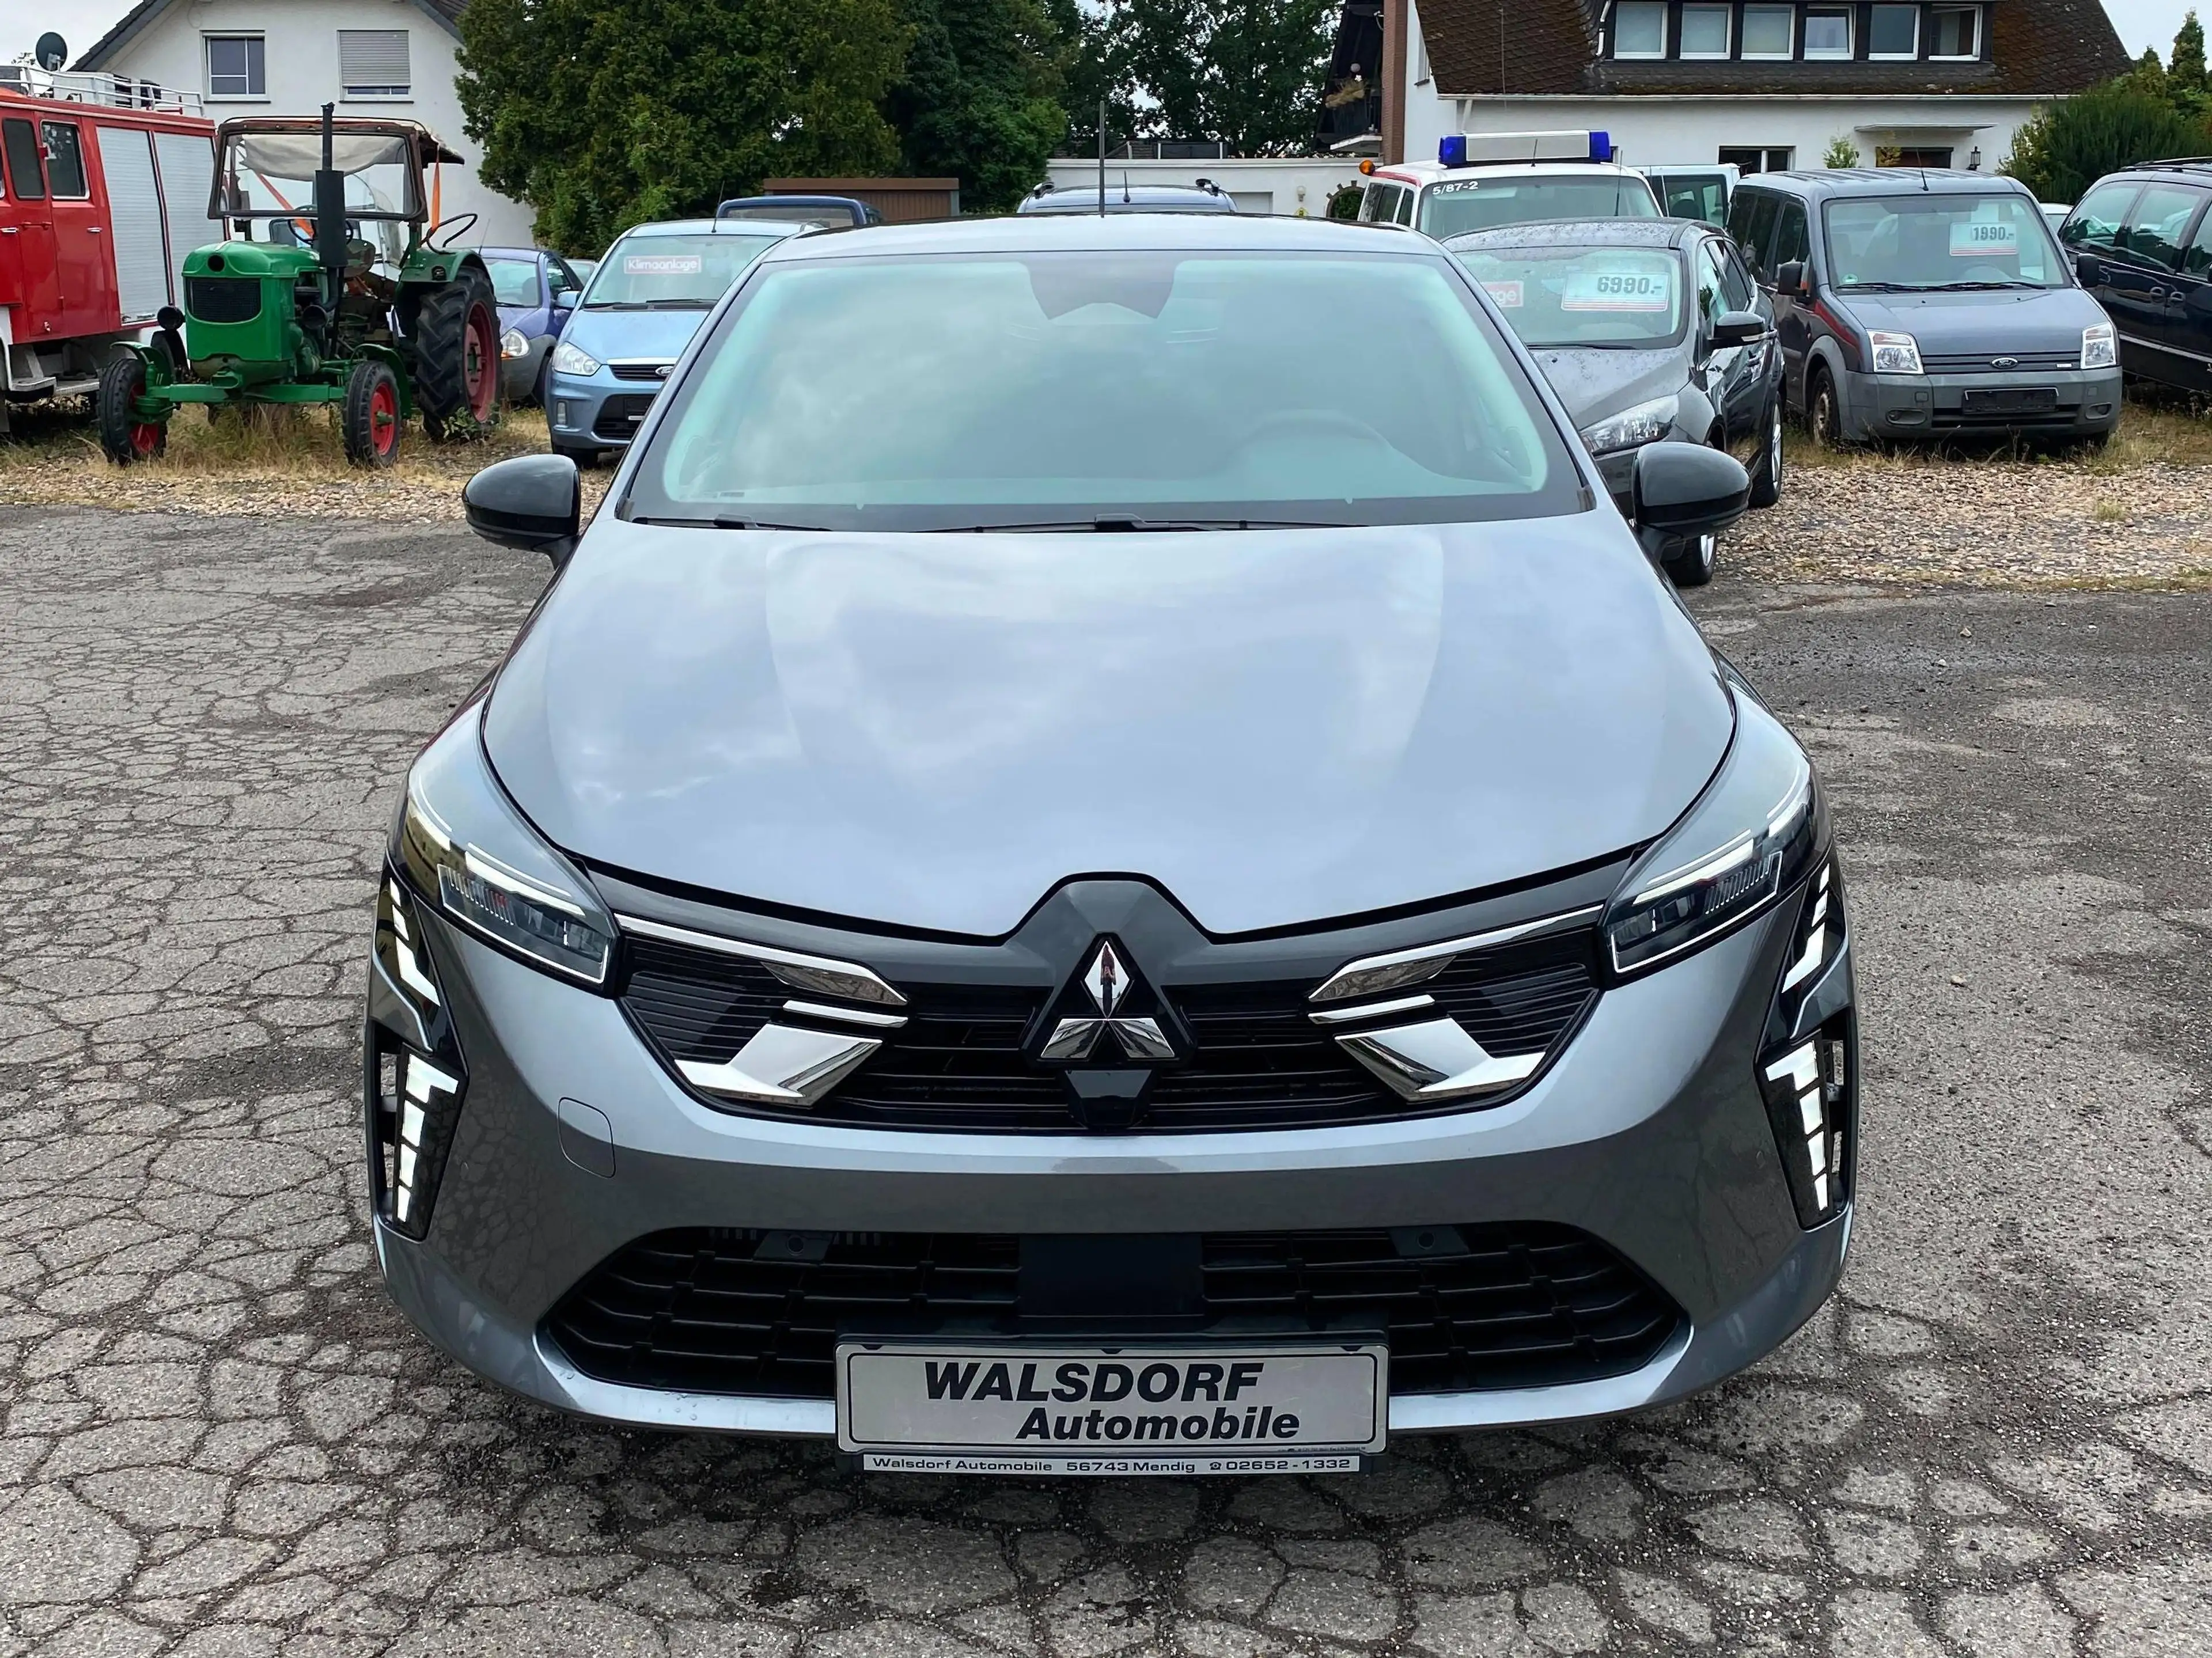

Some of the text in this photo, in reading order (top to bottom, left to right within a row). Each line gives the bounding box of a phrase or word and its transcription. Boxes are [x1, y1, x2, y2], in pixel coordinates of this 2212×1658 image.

[1432, 181, 1479, 195] 5/87-2
[1973, 226, 2014, 241] 1990.-
[628, 258, 697, 271] Klimaanlage
[1597, 276, 1662, 294] 6990.-
[925, 1362, 1264, 1402] WALSDORF
[1016, 1406, 1300, 1440] Automobile
[873, 1458, 952, 1470] Walsdorf
[955, 1460, 1052, 1471] Automobile
[1067, 1462, 1128, 1472] 56743
[1132, 1462, 1196, 1473] Mendig
